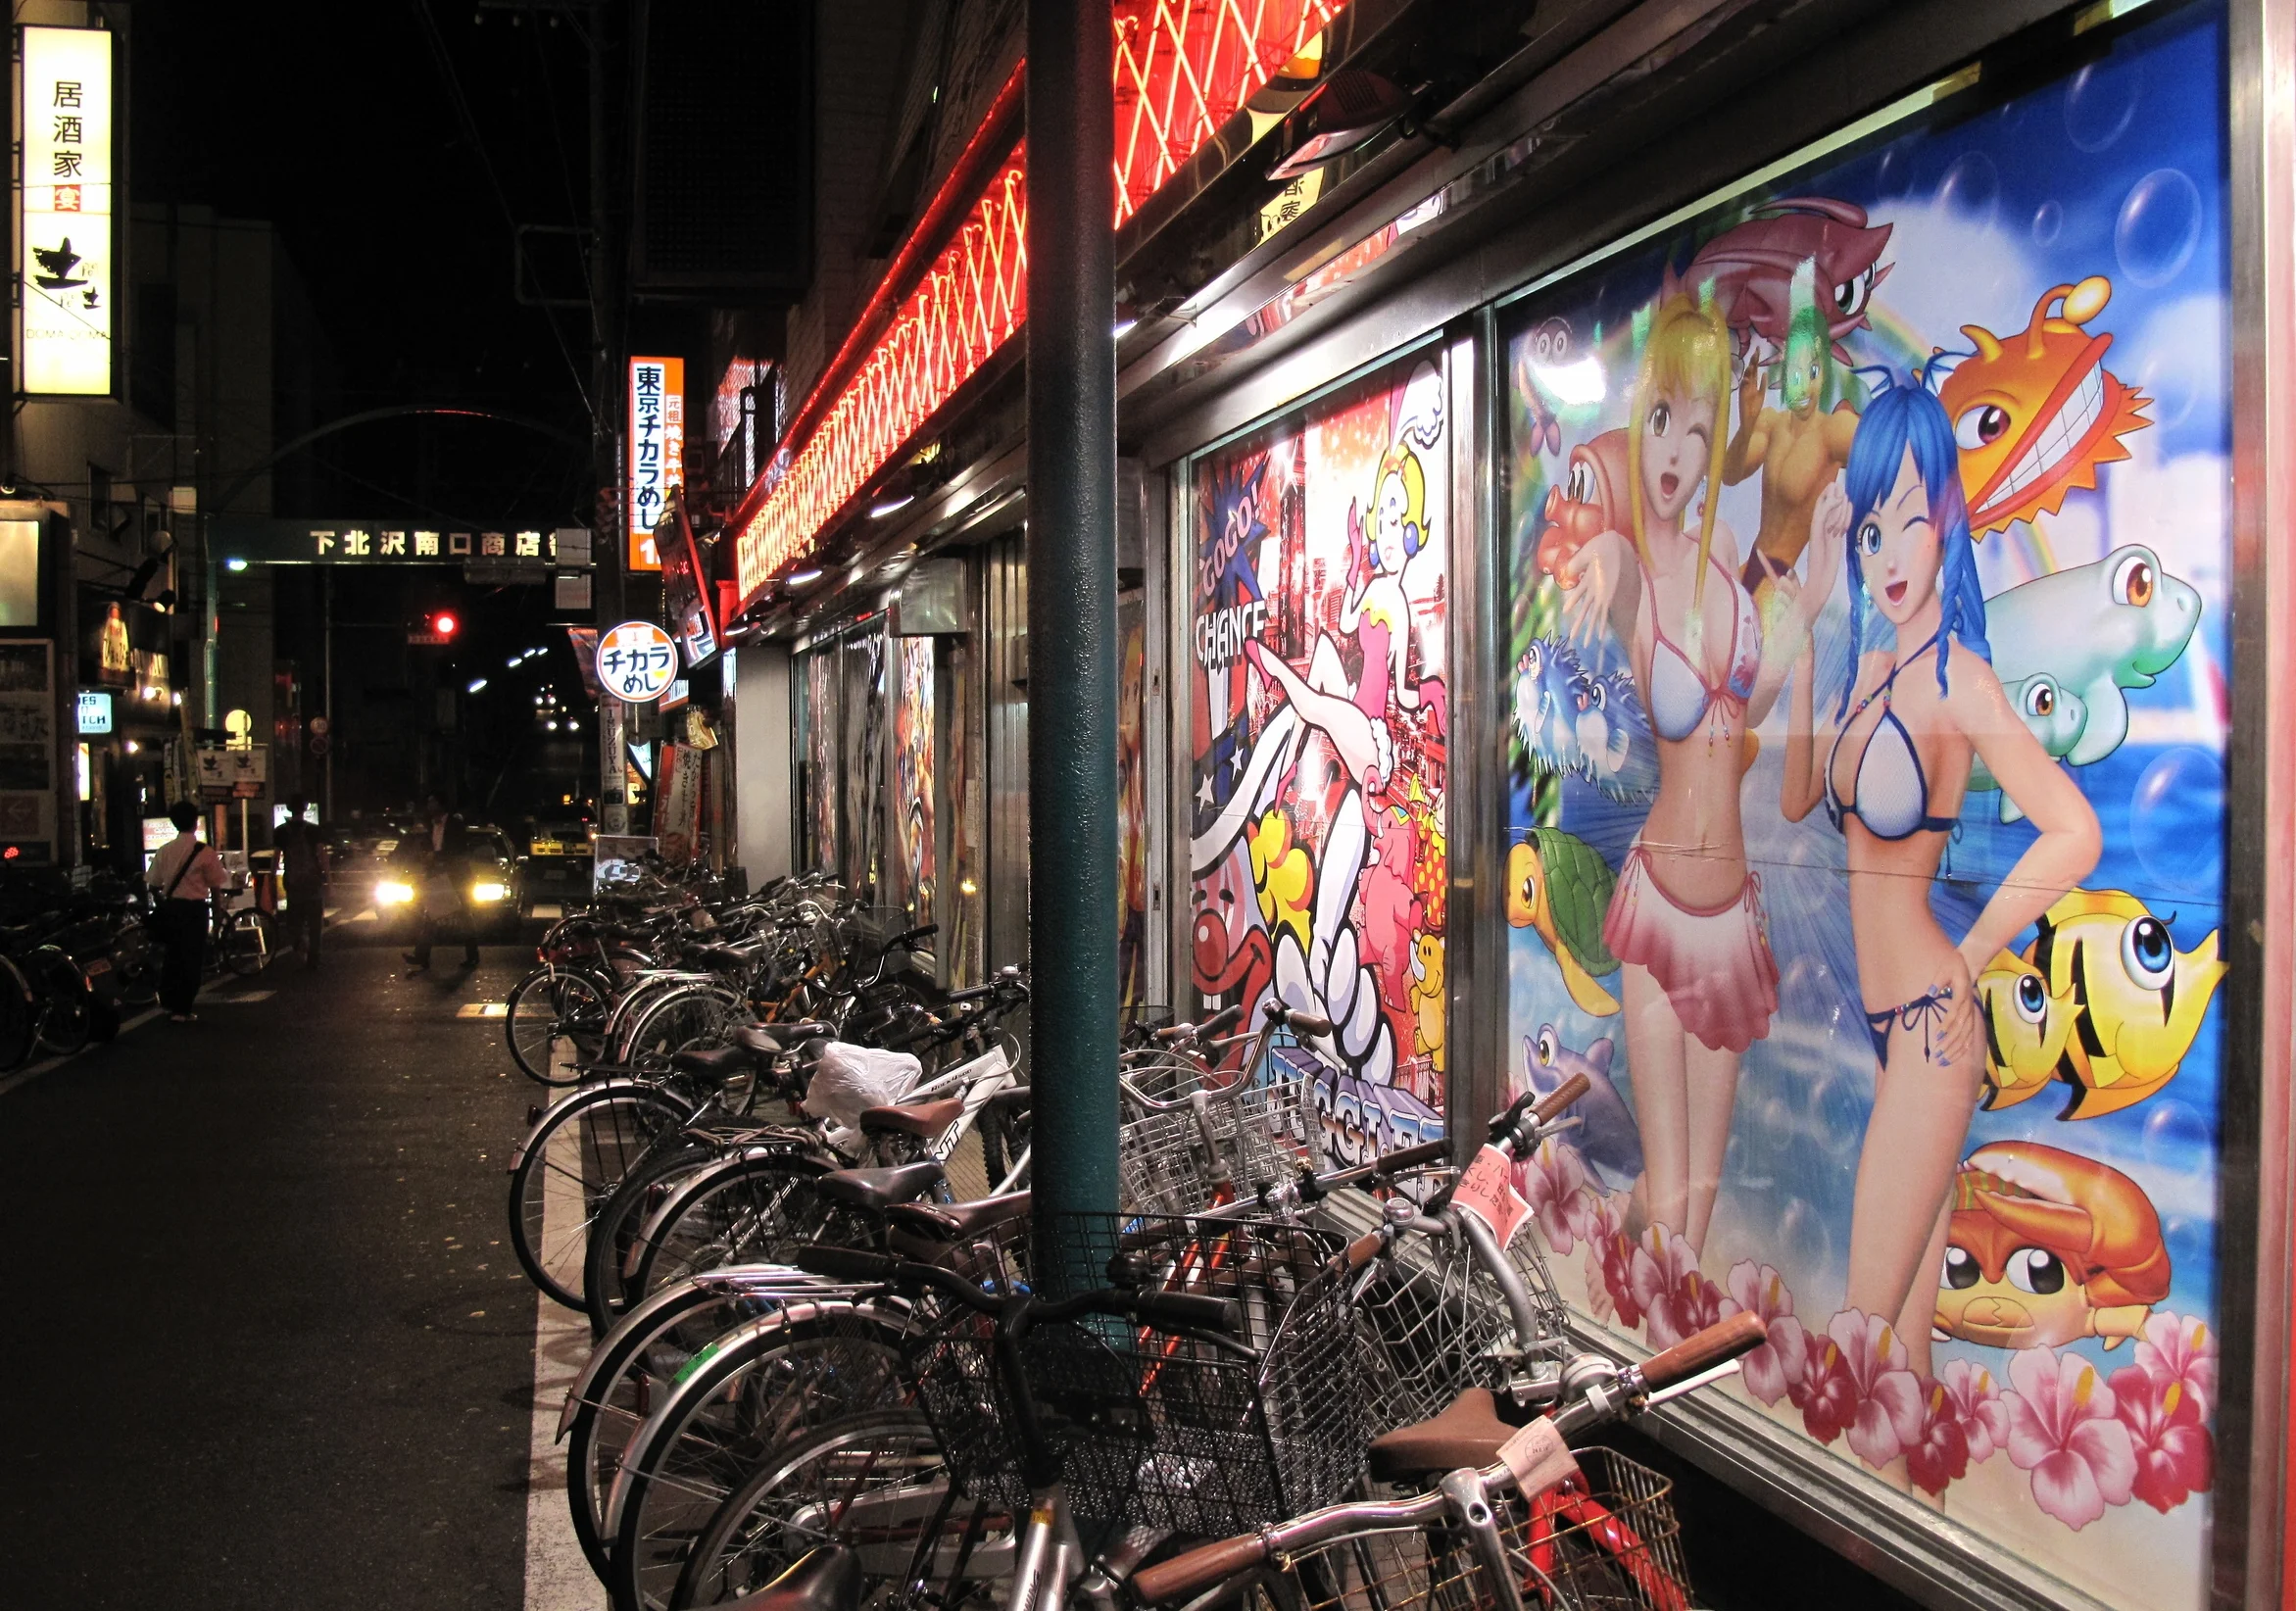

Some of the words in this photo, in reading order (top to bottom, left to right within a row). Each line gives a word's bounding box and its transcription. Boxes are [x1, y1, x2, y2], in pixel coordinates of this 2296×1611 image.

[53, 81, 83, 178] 居酒家
[636, 366, 662, 530] 東京チカラめし
[1202, 480, 1260, 597] GOGO!
[603, 646, 670, 675] チカラ
[622, 672, 660, 693] めし
